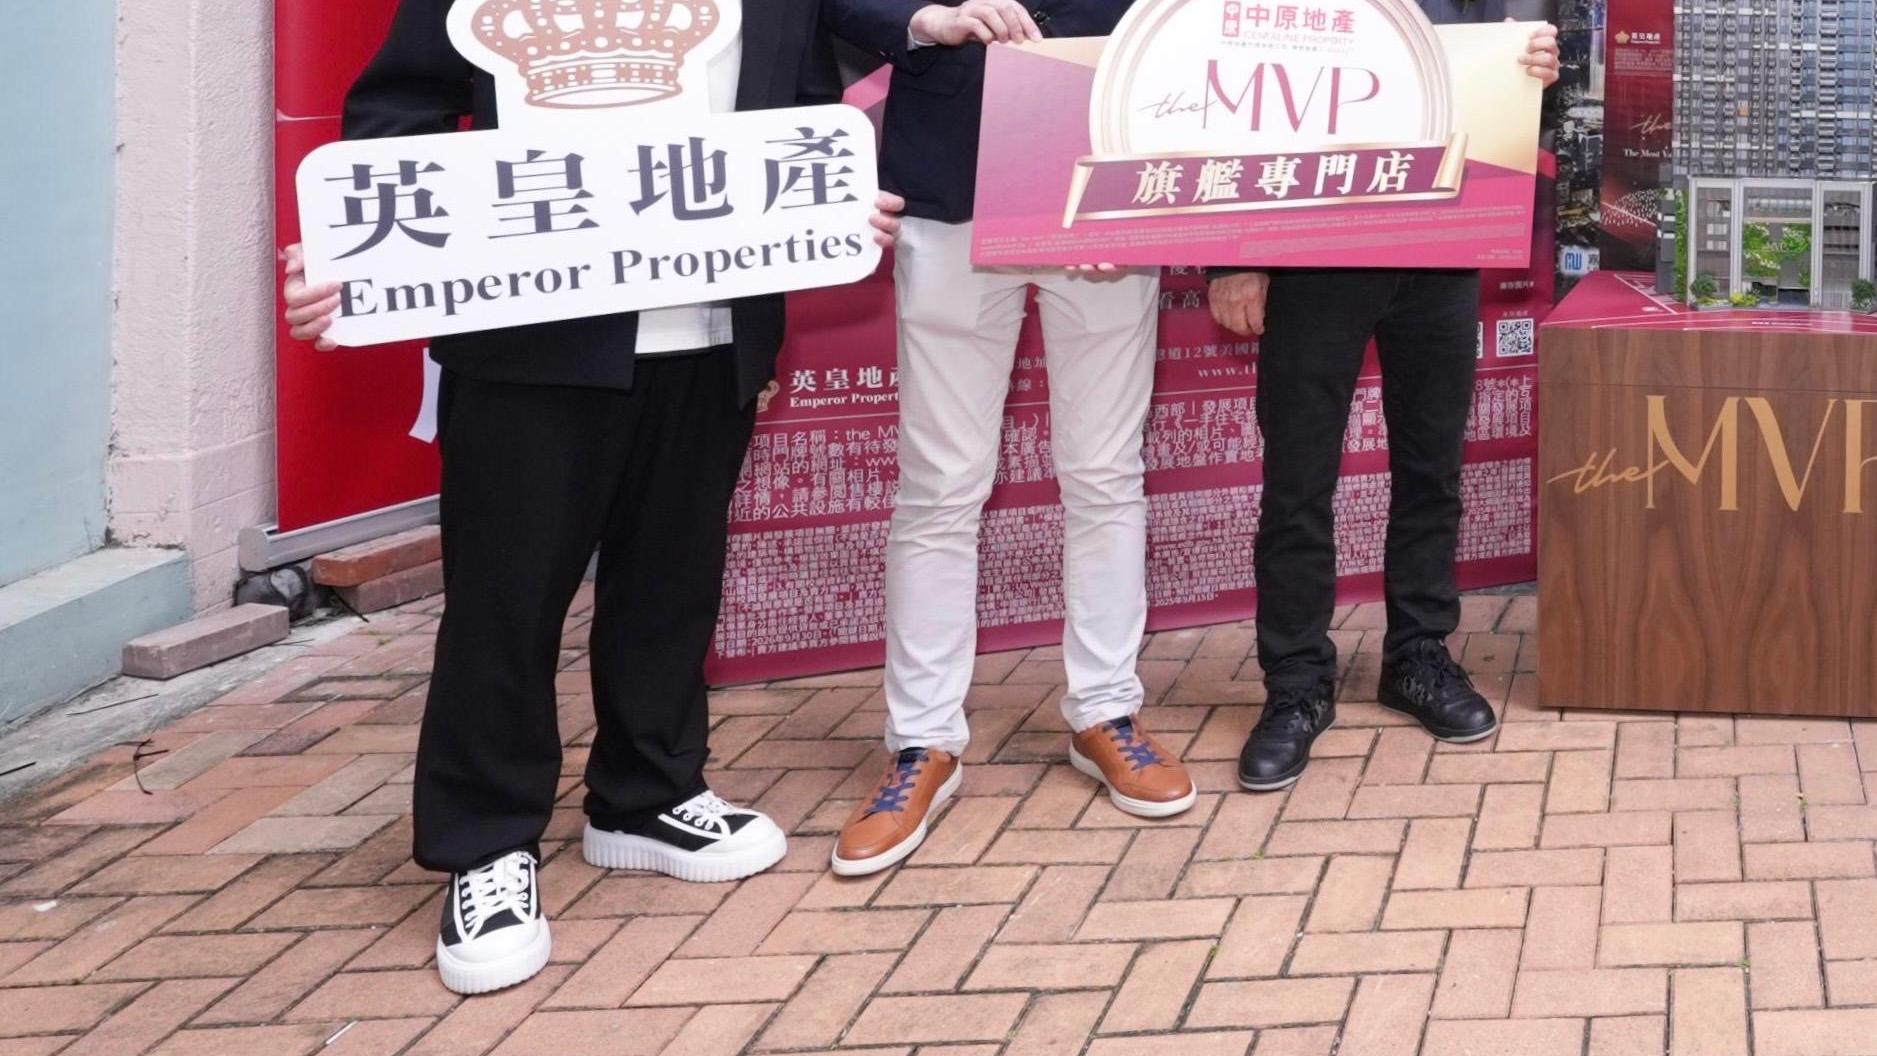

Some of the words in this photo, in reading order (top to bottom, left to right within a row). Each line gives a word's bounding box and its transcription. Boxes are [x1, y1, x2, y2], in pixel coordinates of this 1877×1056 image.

[1245, 3, 1356, 34] 中原地產
[1202, 58, 1380, 135] MVP
[323, 125, 861, 262] 英皇地產
[1131, 150, 1416, 206] 旗艦專門店
[334, 260, 593, 318] Emperor
[610, 228, 864, 286] Properties
[789, 395, 848, 409] Emperor
[1546, 447, 1671, 495] the
